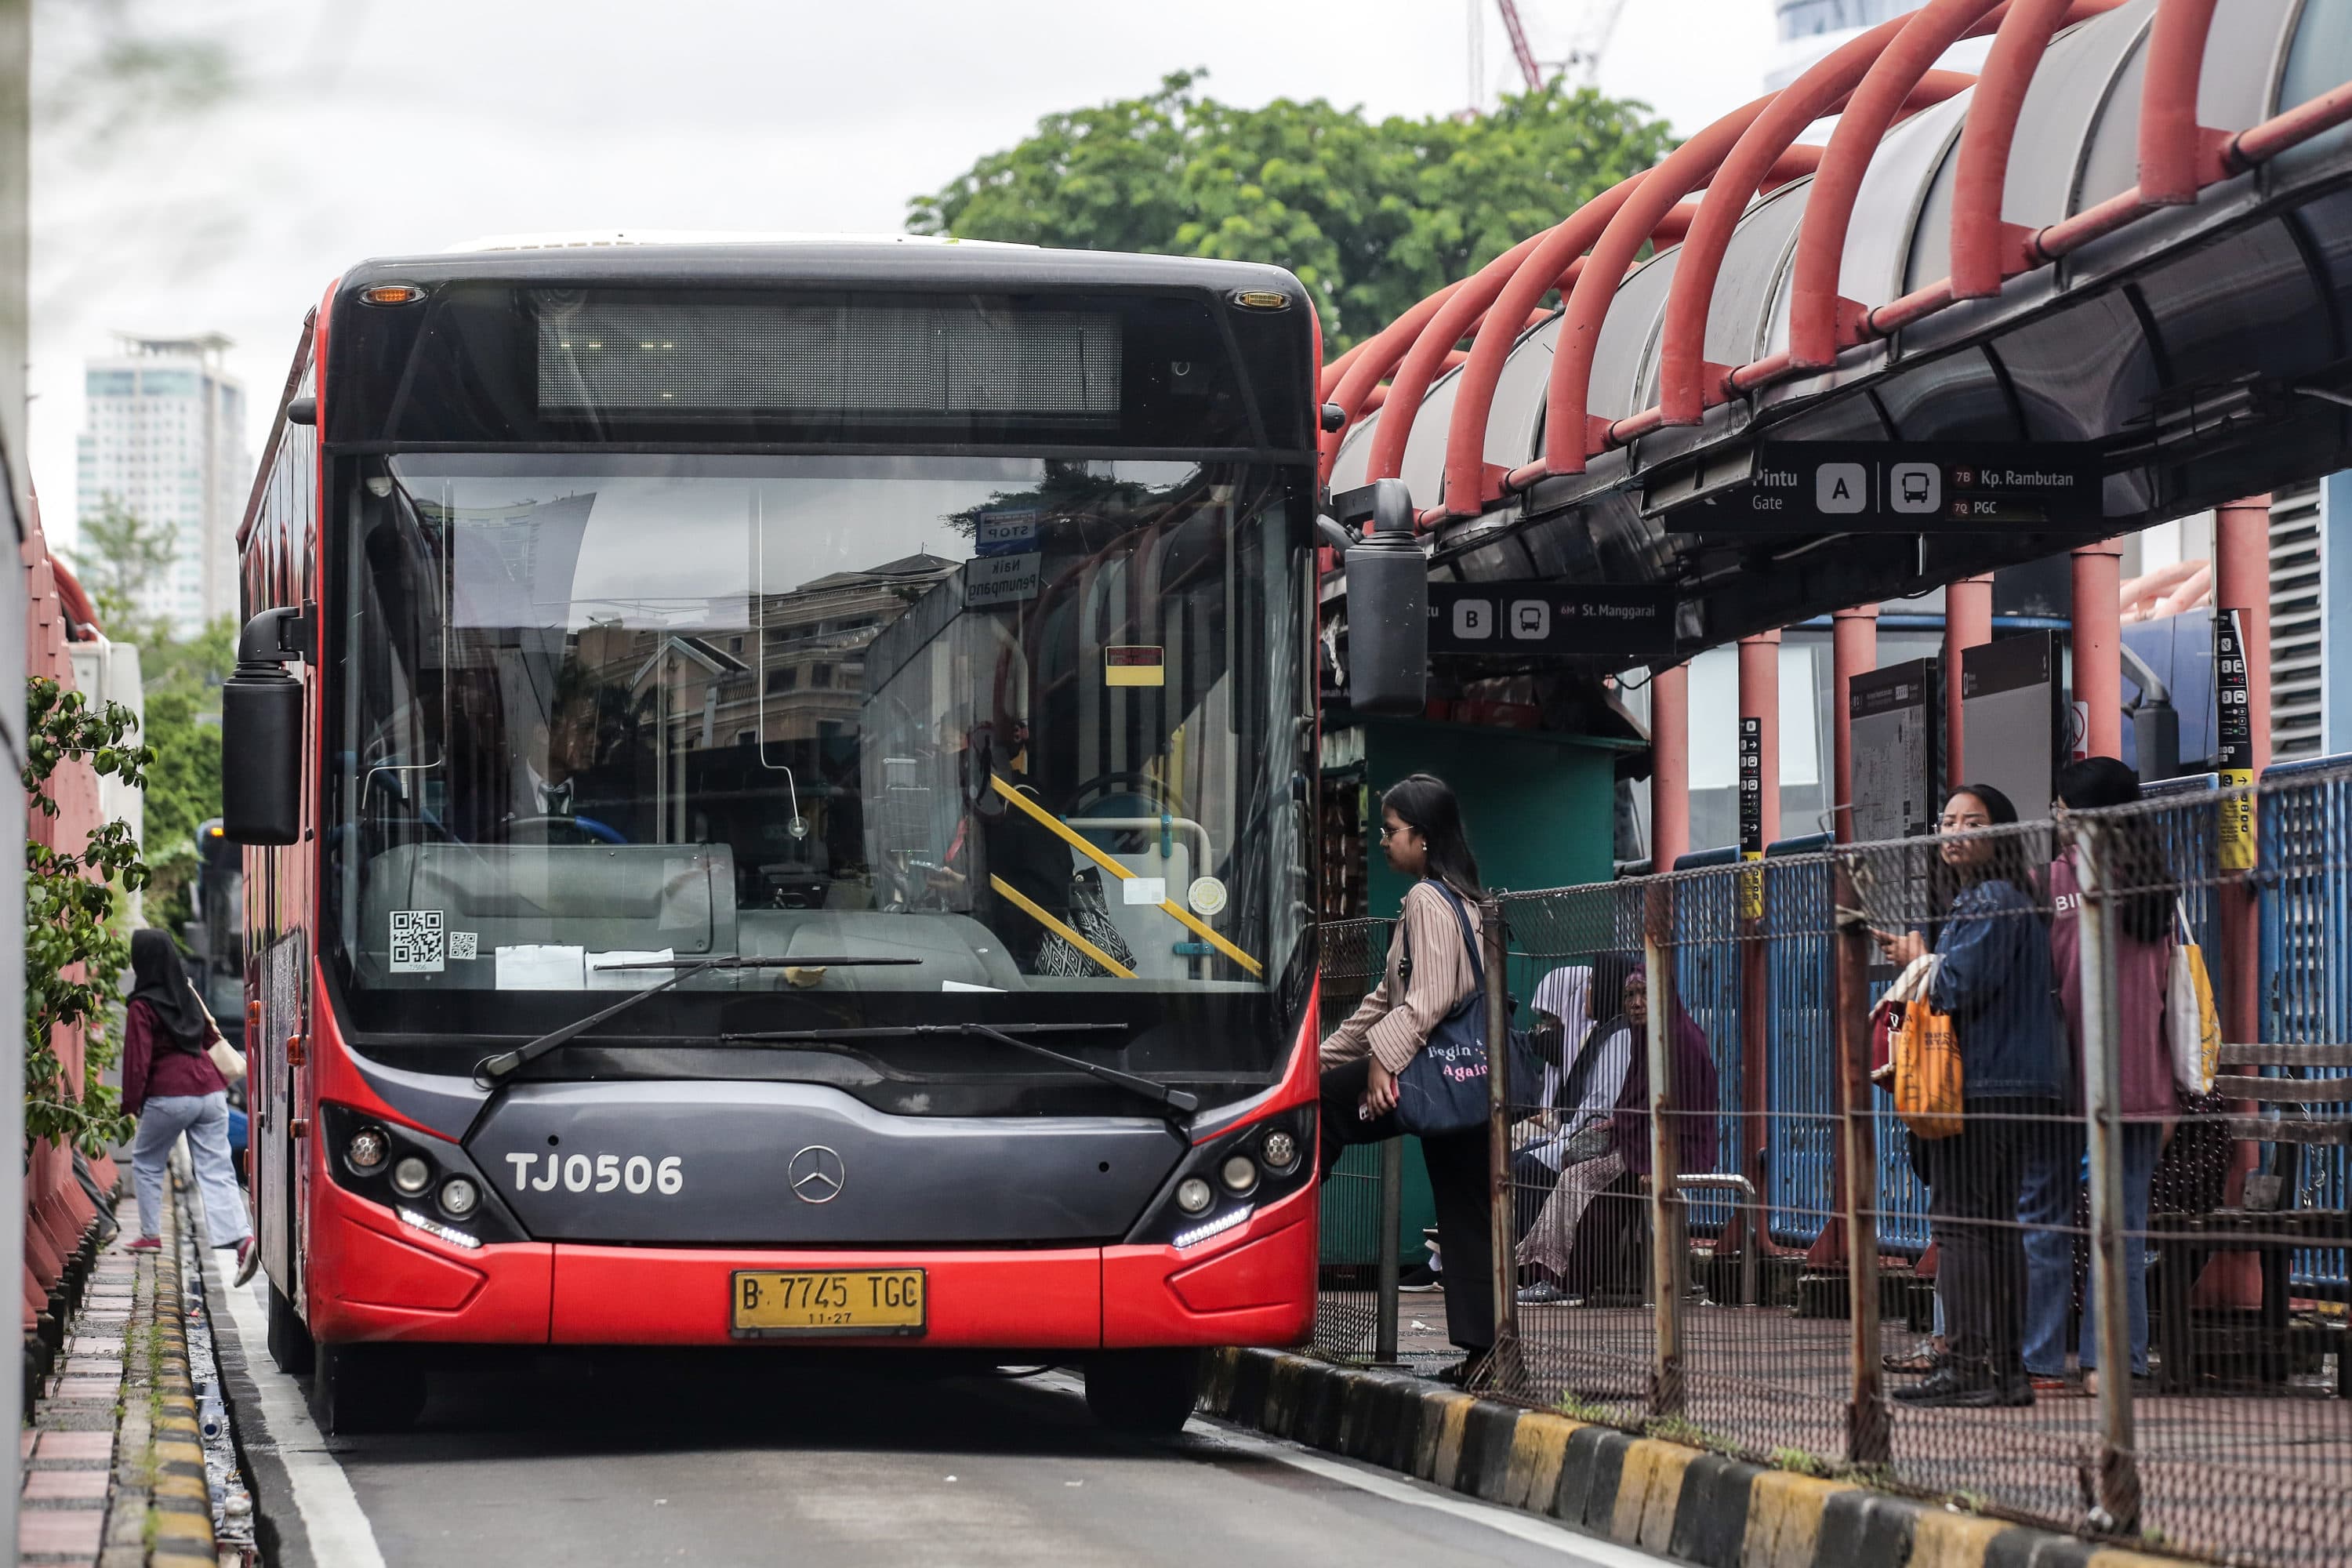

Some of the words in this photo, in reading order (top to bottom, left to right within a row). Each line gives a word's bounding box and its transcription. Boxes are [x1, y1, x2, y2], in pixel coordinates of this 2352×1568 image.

[1831, 477, 1851, 499] A
[1956, 472, 1970, 482] 7B
[1981, 470, 2003, 488] Kp.
[2005, 470, 2074, 486] Rambutan
[1752, 495, 1783, 510] Gate
[1974, 502, 1997, 514] PGC
[1466, 611, 1479, 628] B
[1582, 604, 1596, 616] St.
[1599, 604, 1656, 620] Manggarai
[1428, 1044, 1472, 1062] Begin
[506, 1152, 684, 1195] TJ0506
[743, 1279, 758, 1309] B
[780, 1277, 848, 1308] 7745
[867, 1276, 918, 1308] TGC
